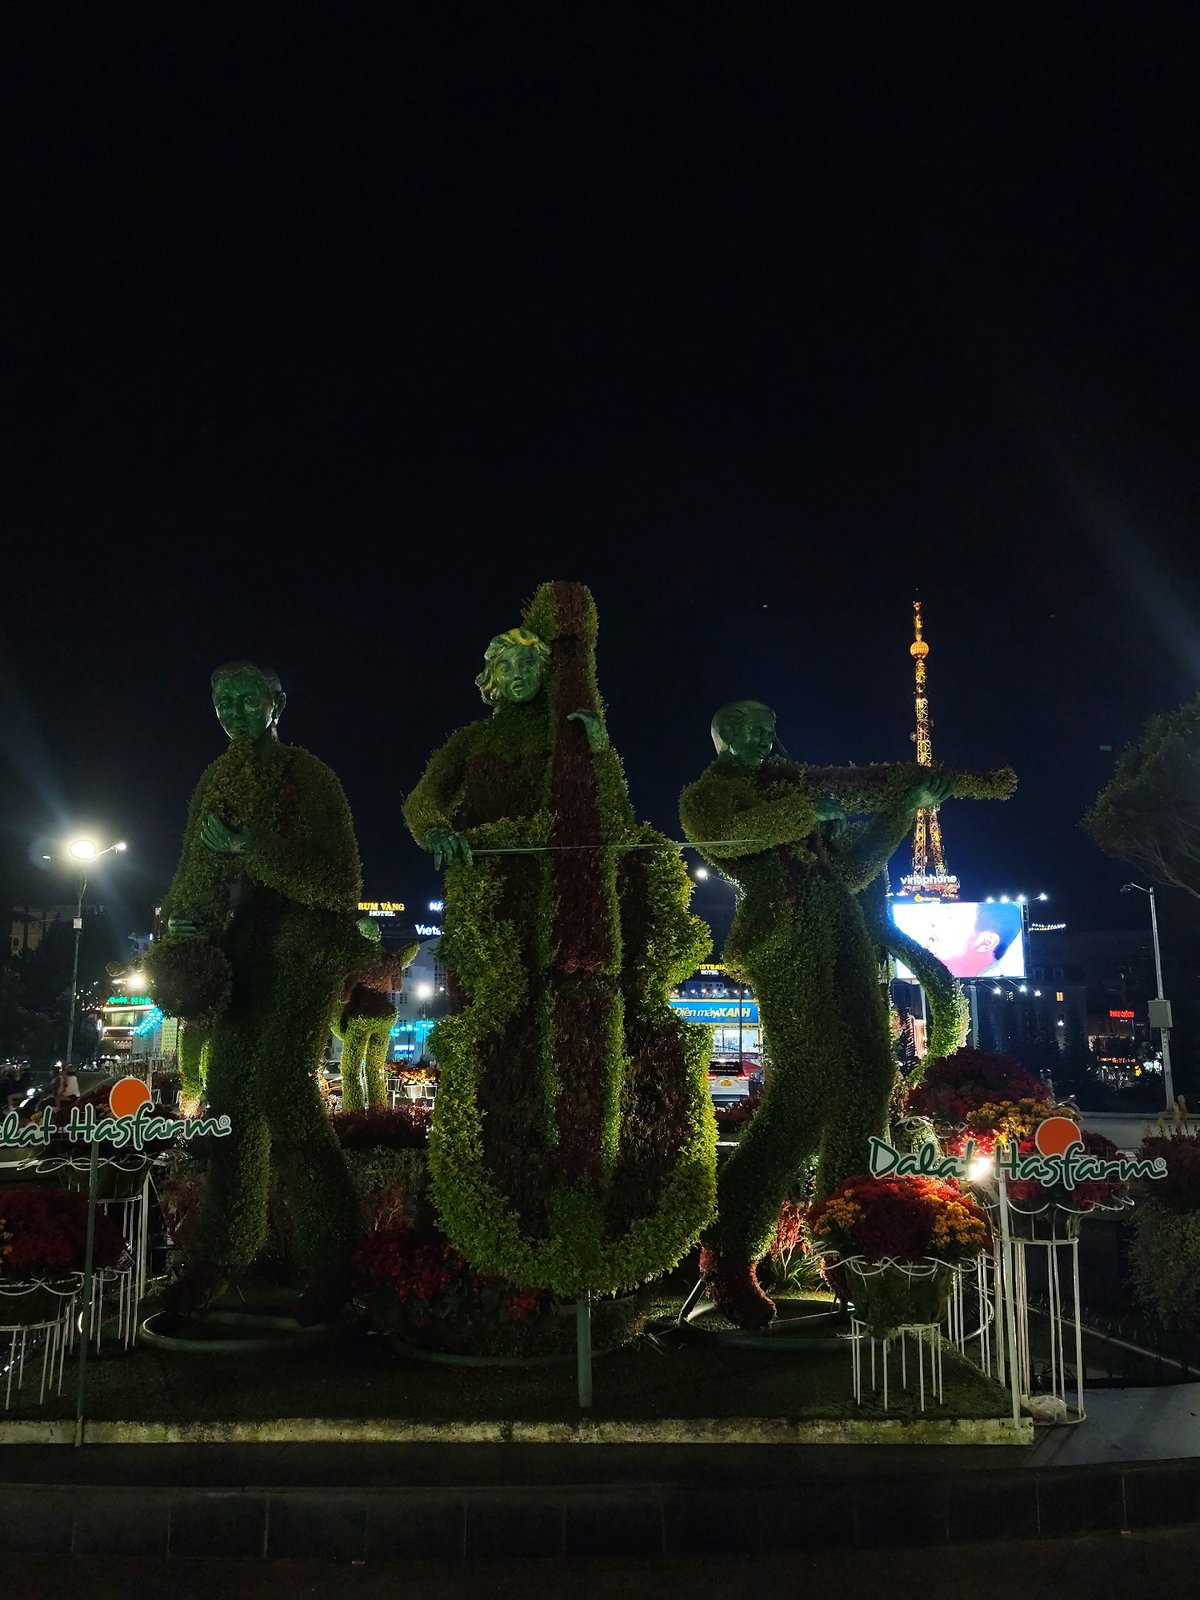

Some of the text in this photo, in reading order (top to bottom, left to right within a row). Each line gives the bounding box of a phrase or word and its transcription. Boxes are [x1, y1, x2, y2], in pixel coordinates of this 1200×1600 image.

[900, 874, 957, 885] vinaphone
[358, 901, 405, 911] RUM VÀNG
[67, 1101, 231, 1150] Hasfarm
[869, 1136, 1168, 1190] Dalat Hasfarm
